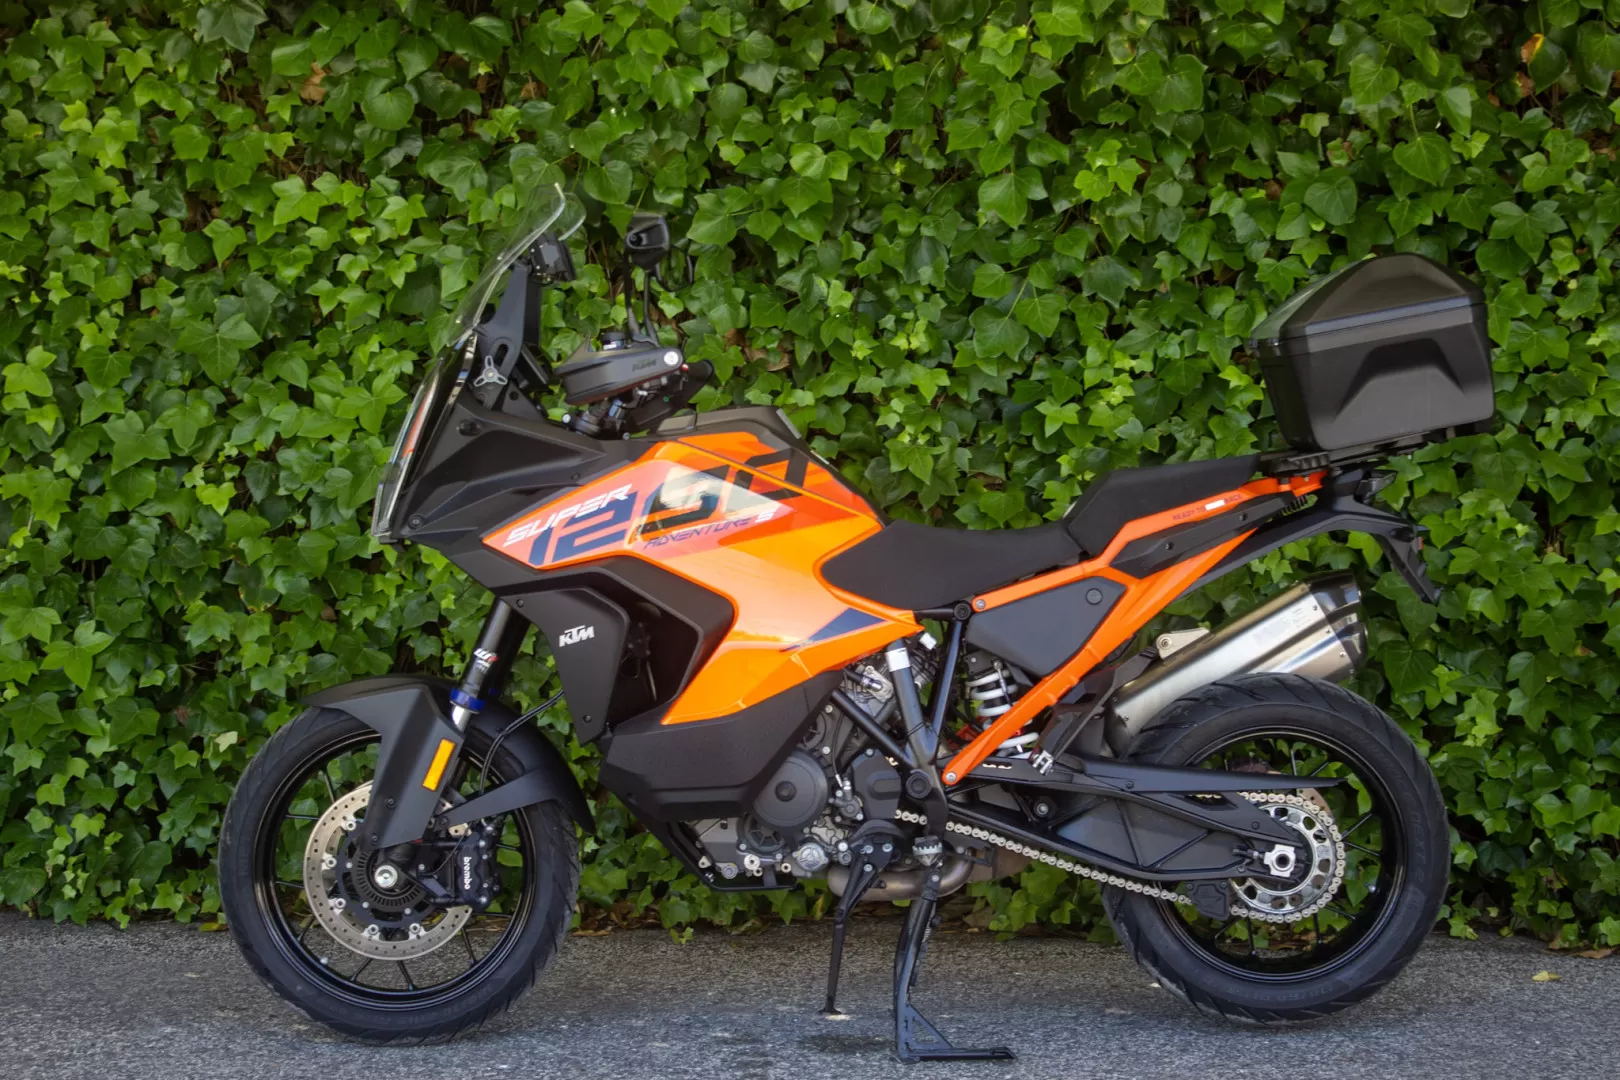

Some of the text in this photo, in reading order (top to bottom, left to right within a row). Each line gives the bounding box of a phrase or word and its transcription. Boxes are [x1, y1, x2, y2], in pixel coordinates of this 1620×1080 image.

[503, 483, 633, 548] SUPER
[643, 511, 777, 550] ADVENTURE S
[558, 625, 596, 648] KTM
[463, 856, 473, 890] brembo
